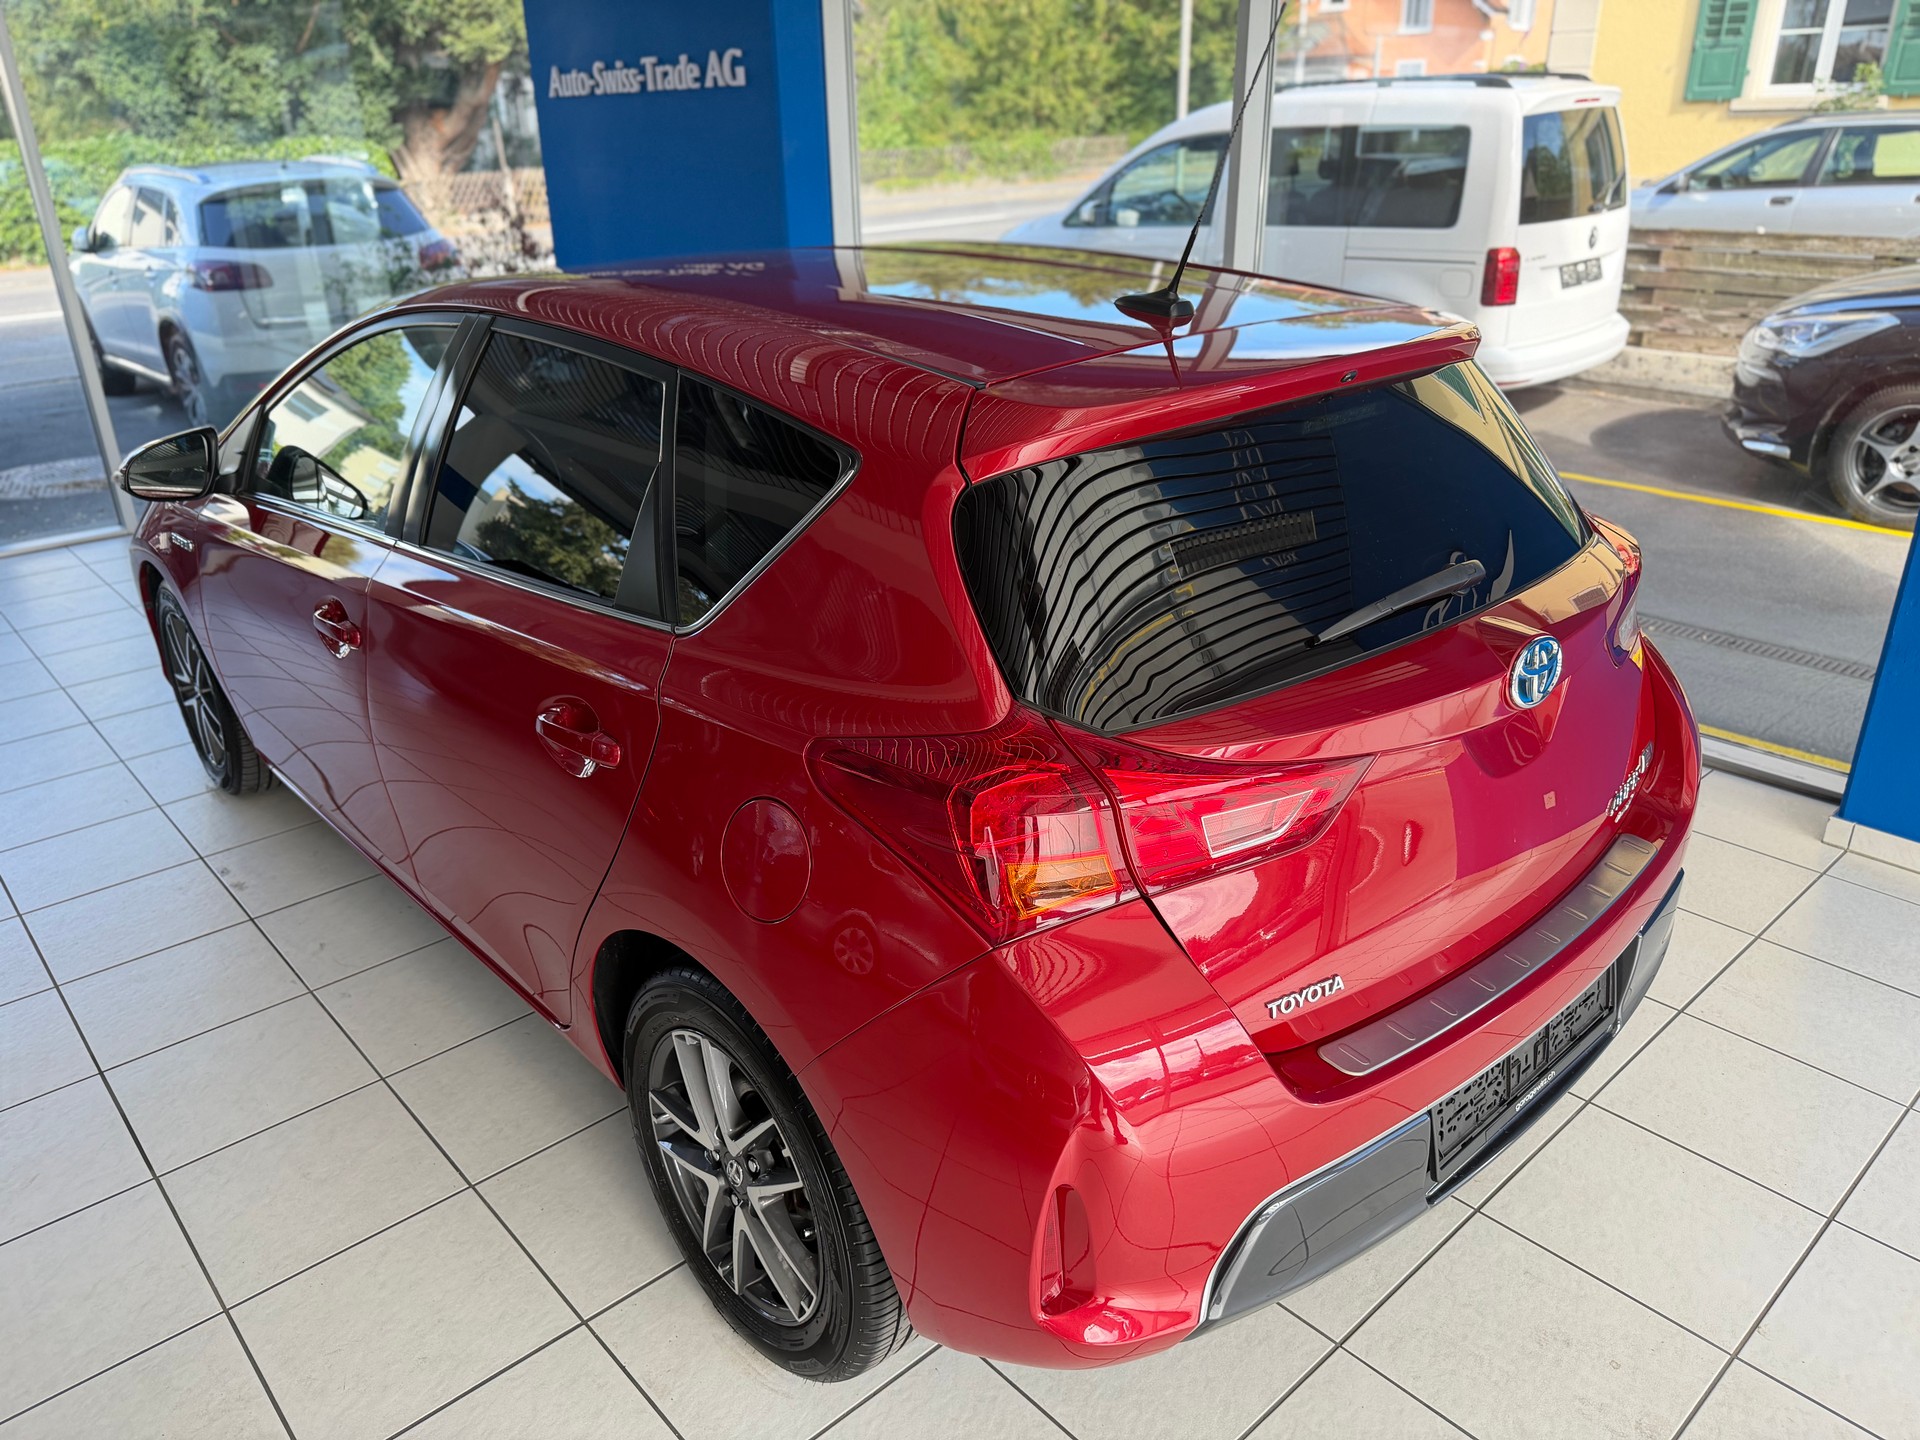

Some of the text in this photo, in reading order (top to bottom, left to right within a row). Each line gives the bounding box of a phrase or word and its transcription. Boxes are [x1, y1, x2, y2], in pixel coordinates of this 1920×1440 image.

[549, 48, 746, 98] Auto-Swiss-Trade AG
[1264, 973, 1345, 1019] TOYOTA
